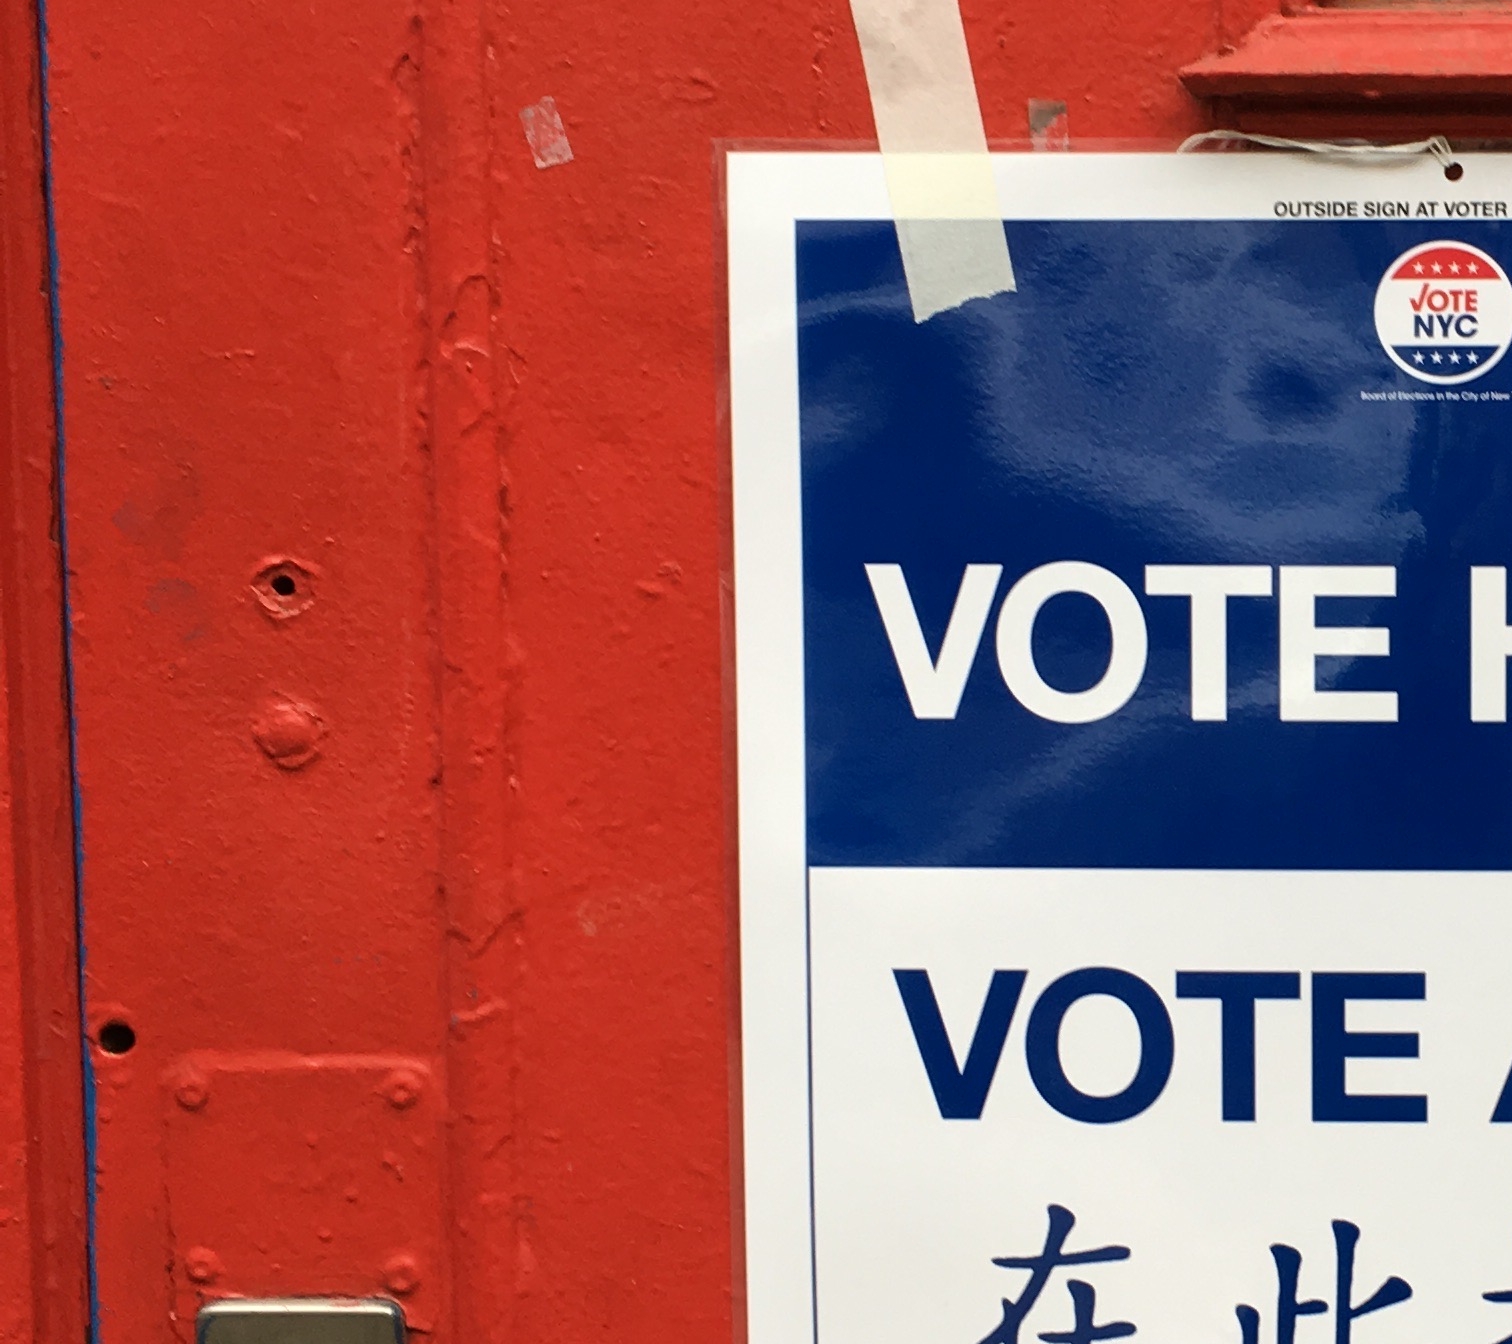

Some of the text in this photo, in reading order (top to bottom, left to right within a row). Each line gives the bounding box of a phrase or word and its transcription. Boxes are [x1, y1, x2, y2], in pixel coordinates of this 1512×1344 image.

[1273, 201, 1358, 217] OUTSIDE
[1363, 201, 1410, 217] SIGN
[1415, 201, 1439, 217] AT
[1443, 201, 1507, 217] VOTER
[1409, 283, 1478, 312] VOTE
[1413, 314, 1478, 338] NYC
[1360, 390, 1387, 401] Board
[1387, 390, 1397, 401] of
[1397, 390, 1436, 401] Elections
[1460, 391, 1479, 402] City
[1480, 391, 1490, 401] of
[1490, 391, 1511, 401] New
[864, 560, 1399, 723] VOTE
[892, 966, 1429, 1125] VOTE
